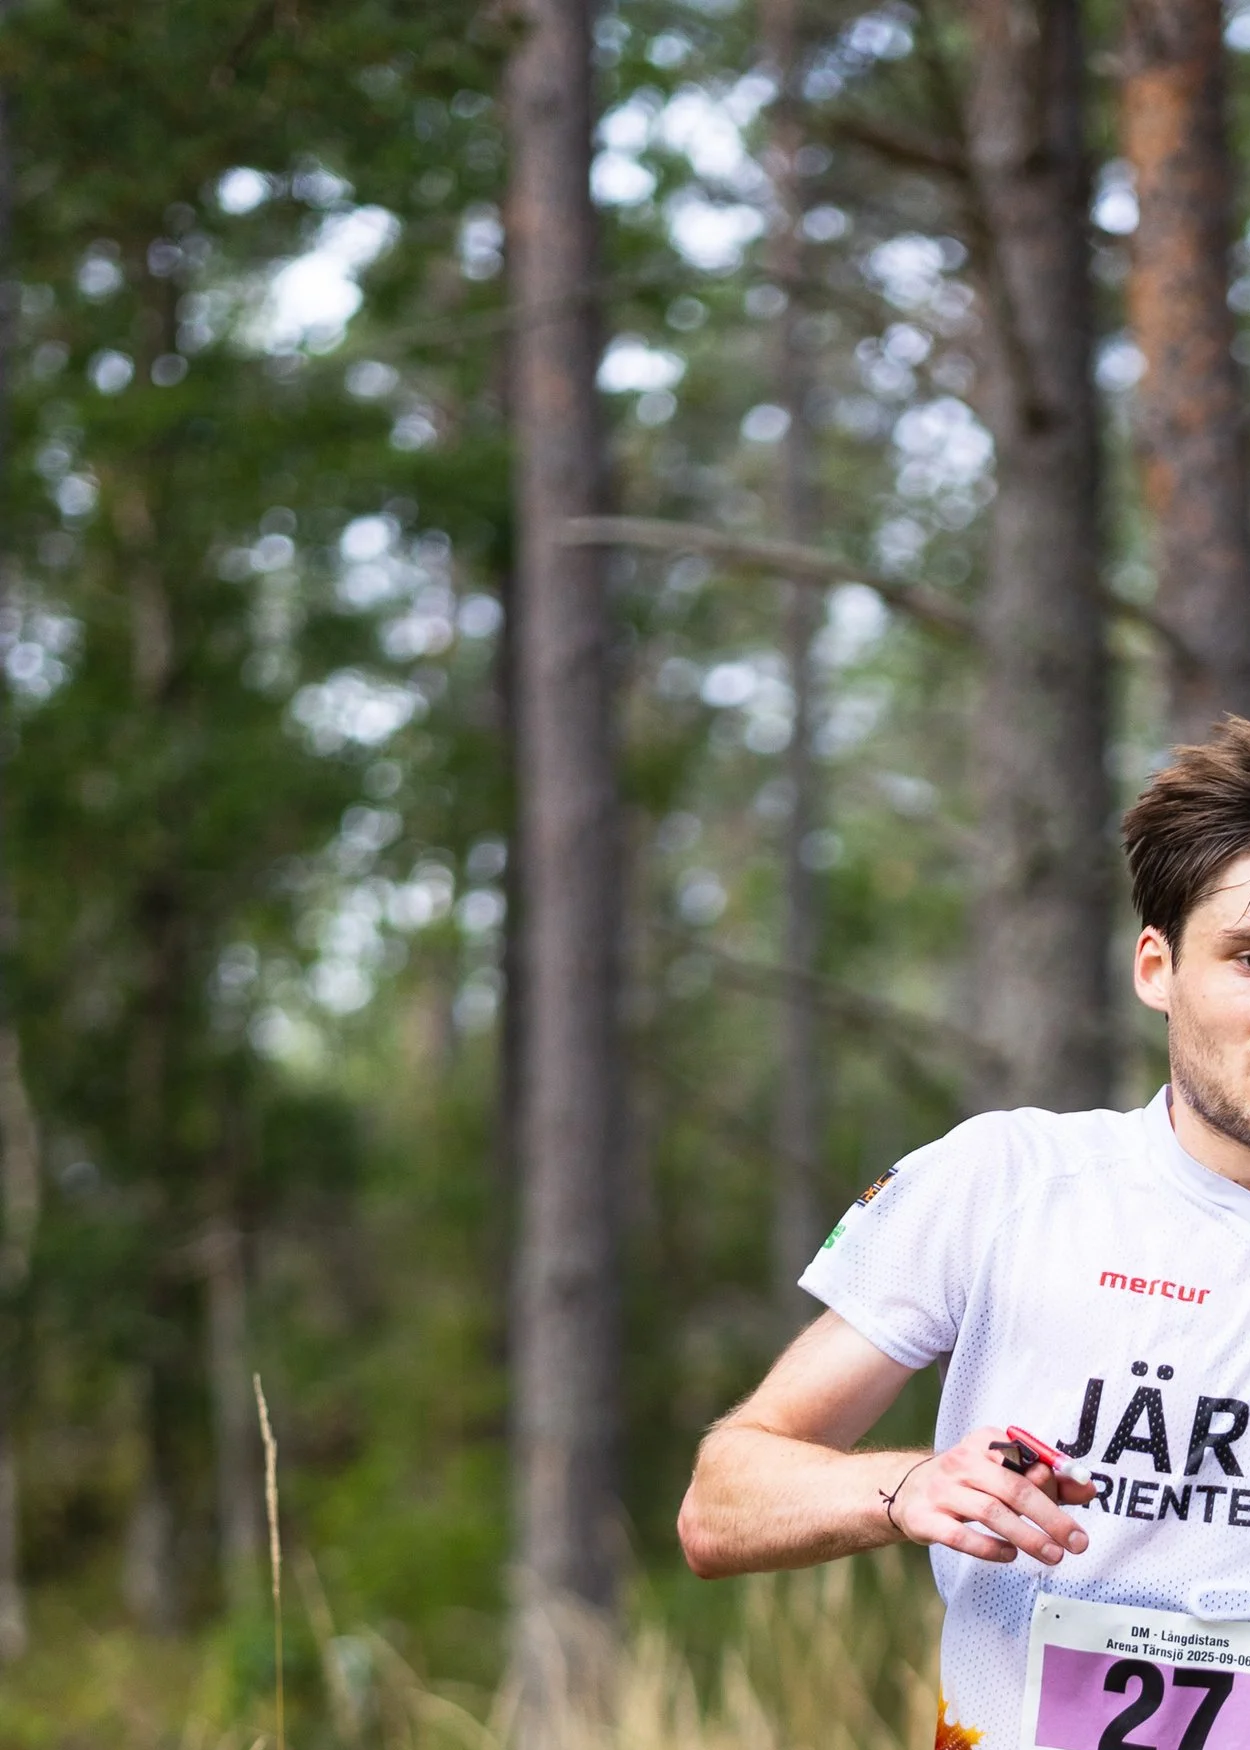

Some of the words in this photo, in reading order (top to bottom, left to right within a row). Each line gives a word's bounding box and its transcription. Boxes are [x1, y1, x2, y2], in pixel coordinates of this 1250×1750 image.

[1099, 1270, 1212, 1305] mercur
[1131, 1625, 1150, 1640] DM
[1161, 1629, 1230, 1648] Långdistans
[1106, 1638, 1139, 1655] Arena
[1143, 1643, 1184, 1662] Tärnsjö
